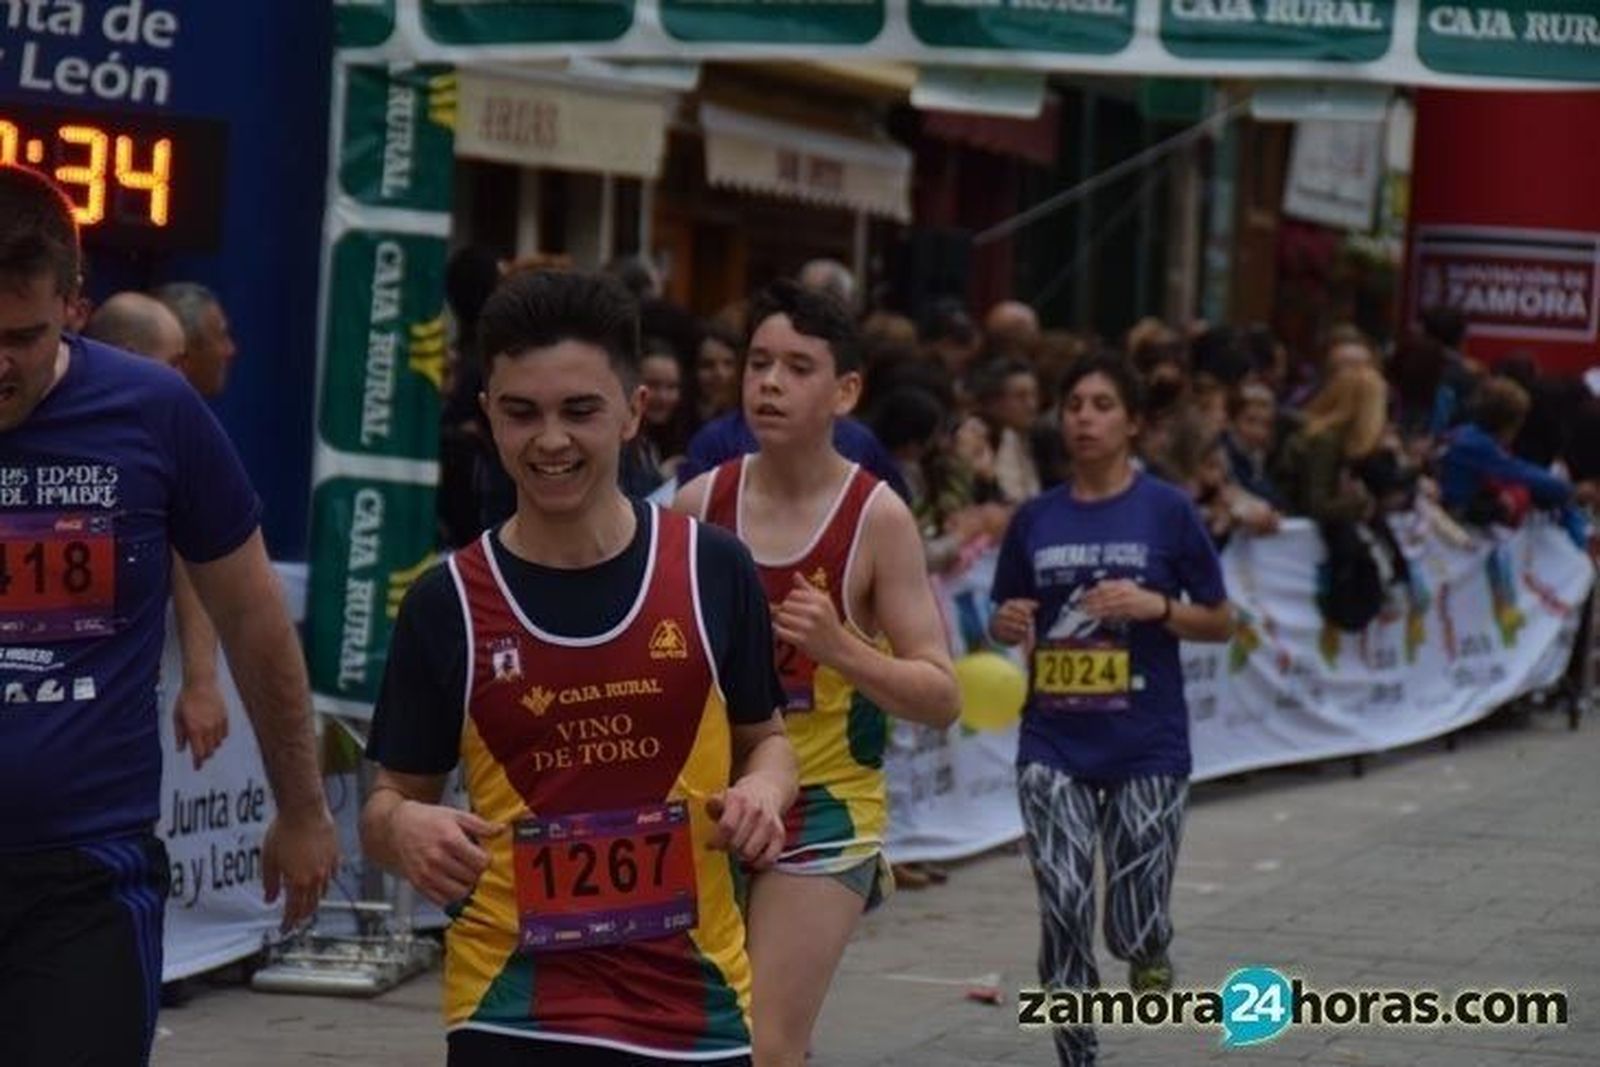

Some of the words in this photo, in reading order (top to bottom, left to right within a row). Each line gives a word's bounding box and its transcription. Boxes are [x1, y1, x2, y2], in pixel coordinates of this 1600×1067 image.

[102, 0, 178, 48] de
[1429, 5, 1514, 40] CAJA
[1523, 11, 1600, 46] RUR
[19, 41, 169, 105] León
[370, 242, 403, 324] CAJA
[361, 330, 396, 445] RURAL
[36, 465, 119, 486] EDADES
[36, 485, 118, 508] HOMBRE
[348, 488, 384, 570] CAJA
[337, 578, 375, 690] RURAL
[559, 688, 601, 704] CAJA
[605, 679, 663, 698] RURAL
[1043, 654, 1118, 686] 2024
[556, 713, 632, 741] VINO
[533, 752, 573, 772] DE
[579, 737, 660, 765] TORO
[167, 787, 229, 839] Junta
[236, 778, 265, 823] de
[185, 857, 205, 909] y
[211, 835, 263, 889] León
[532, 832, 673, 900] 1267
